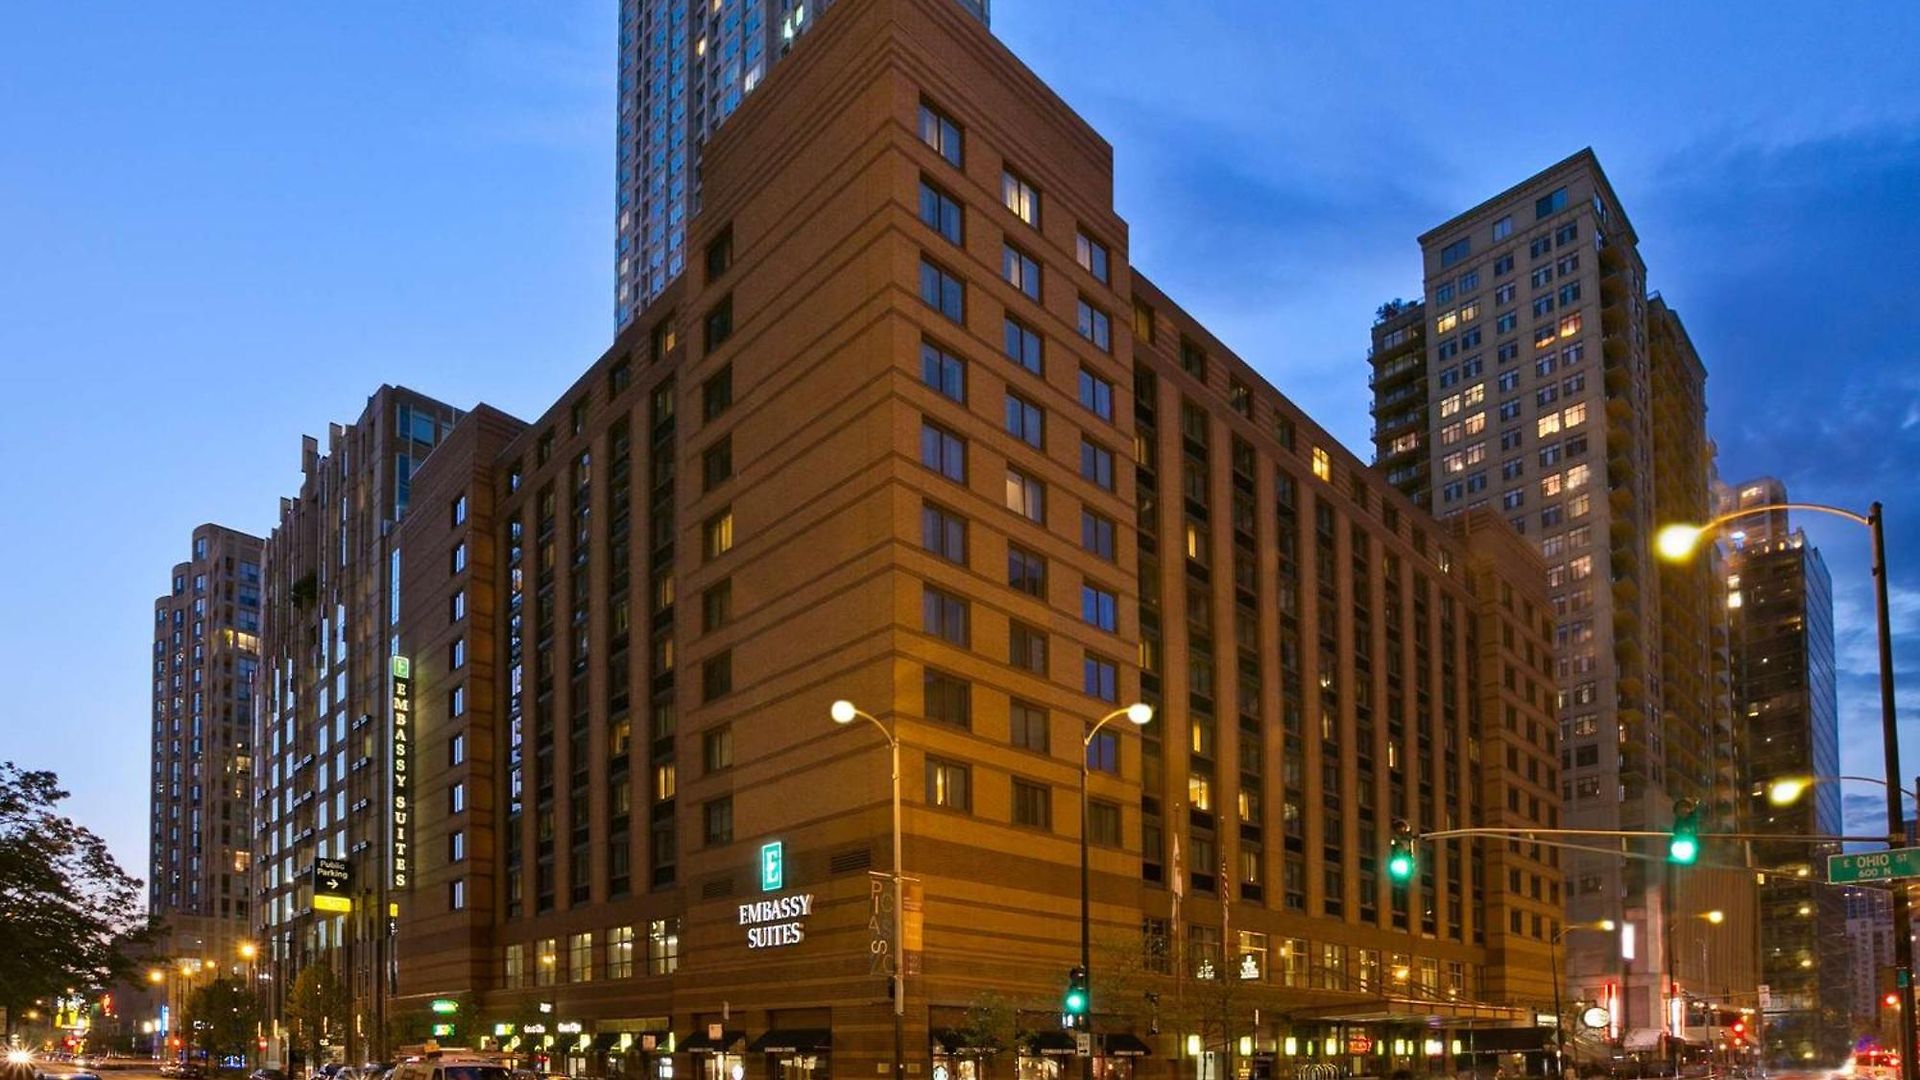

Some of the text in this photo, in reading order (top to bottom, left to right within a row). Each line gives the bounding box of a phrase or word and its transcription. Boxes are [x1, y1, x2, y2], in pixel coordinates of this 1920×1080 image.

[393, 683, 409, 886] EMBASSY SUITES
[320, 860, 345, 870] Public
[1856, 854, 1890, 868] OHIO
[317, 868, 348, 880] Parking
[1858, 867, 1892, 877] 600 N
[739, 894, 812, 925] EMBASSY
[748, 922, 802, 948] SUITES
